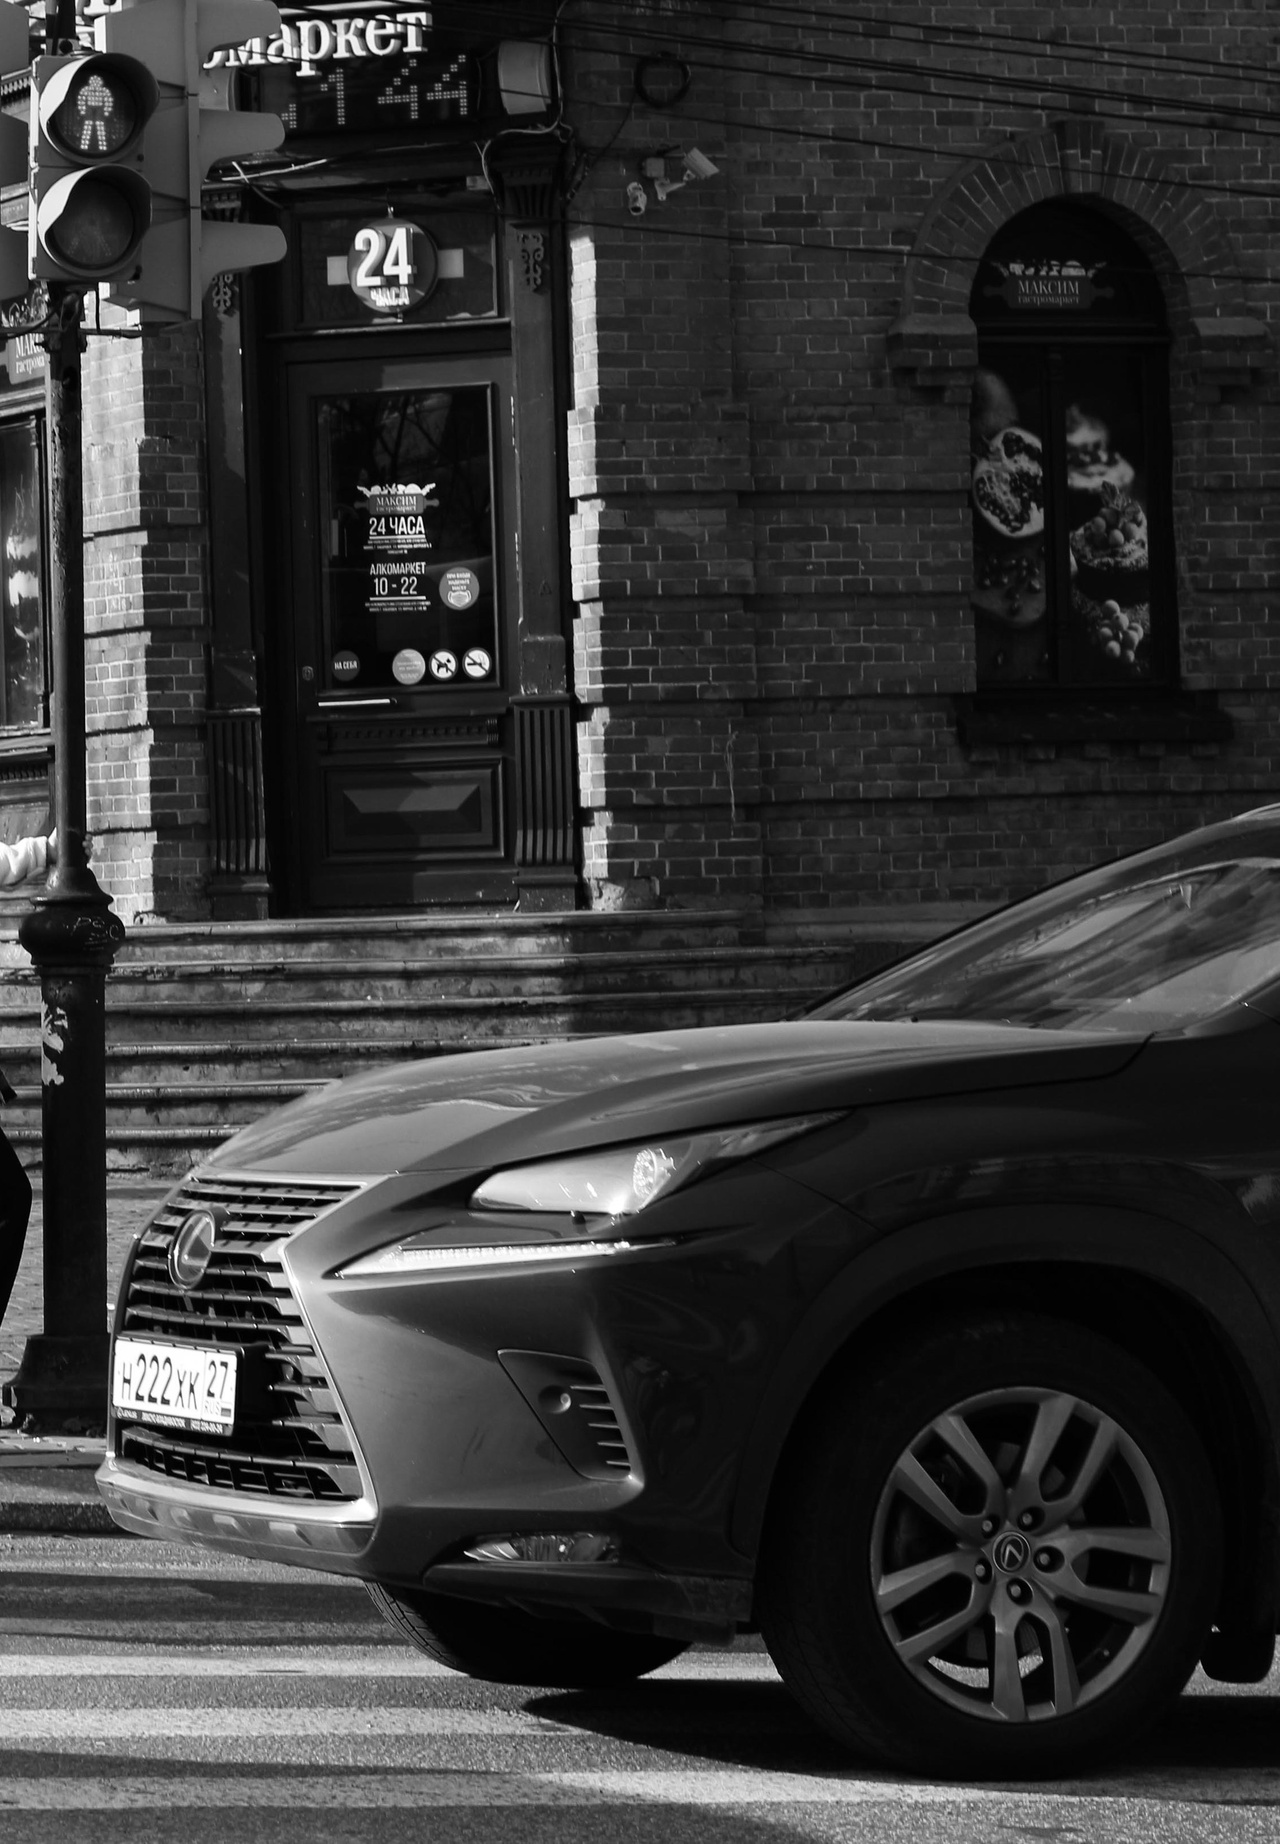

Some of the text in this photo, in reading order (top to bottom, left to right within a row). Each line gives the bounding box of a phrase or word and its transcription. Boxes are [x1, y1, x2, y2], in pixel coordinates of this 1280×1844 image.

[355, 227, 412, 287] 24
[370, 285, 410, 307] ЧАСА
[1018, 279, 1079, 295] МАКСИМ
[376, 495, 417, 506] МАКСИМ
[369, 515, 425, 535] 24 ЧАСА
[369, 561, 426, 575] АЛКОМАРКЕТ
[373, 577, 388, 595] 10
[401, 576, 417, 595] 22
[206, 1360, 229, 1400] 27
[204, 1400, 220, 1417] RUS
